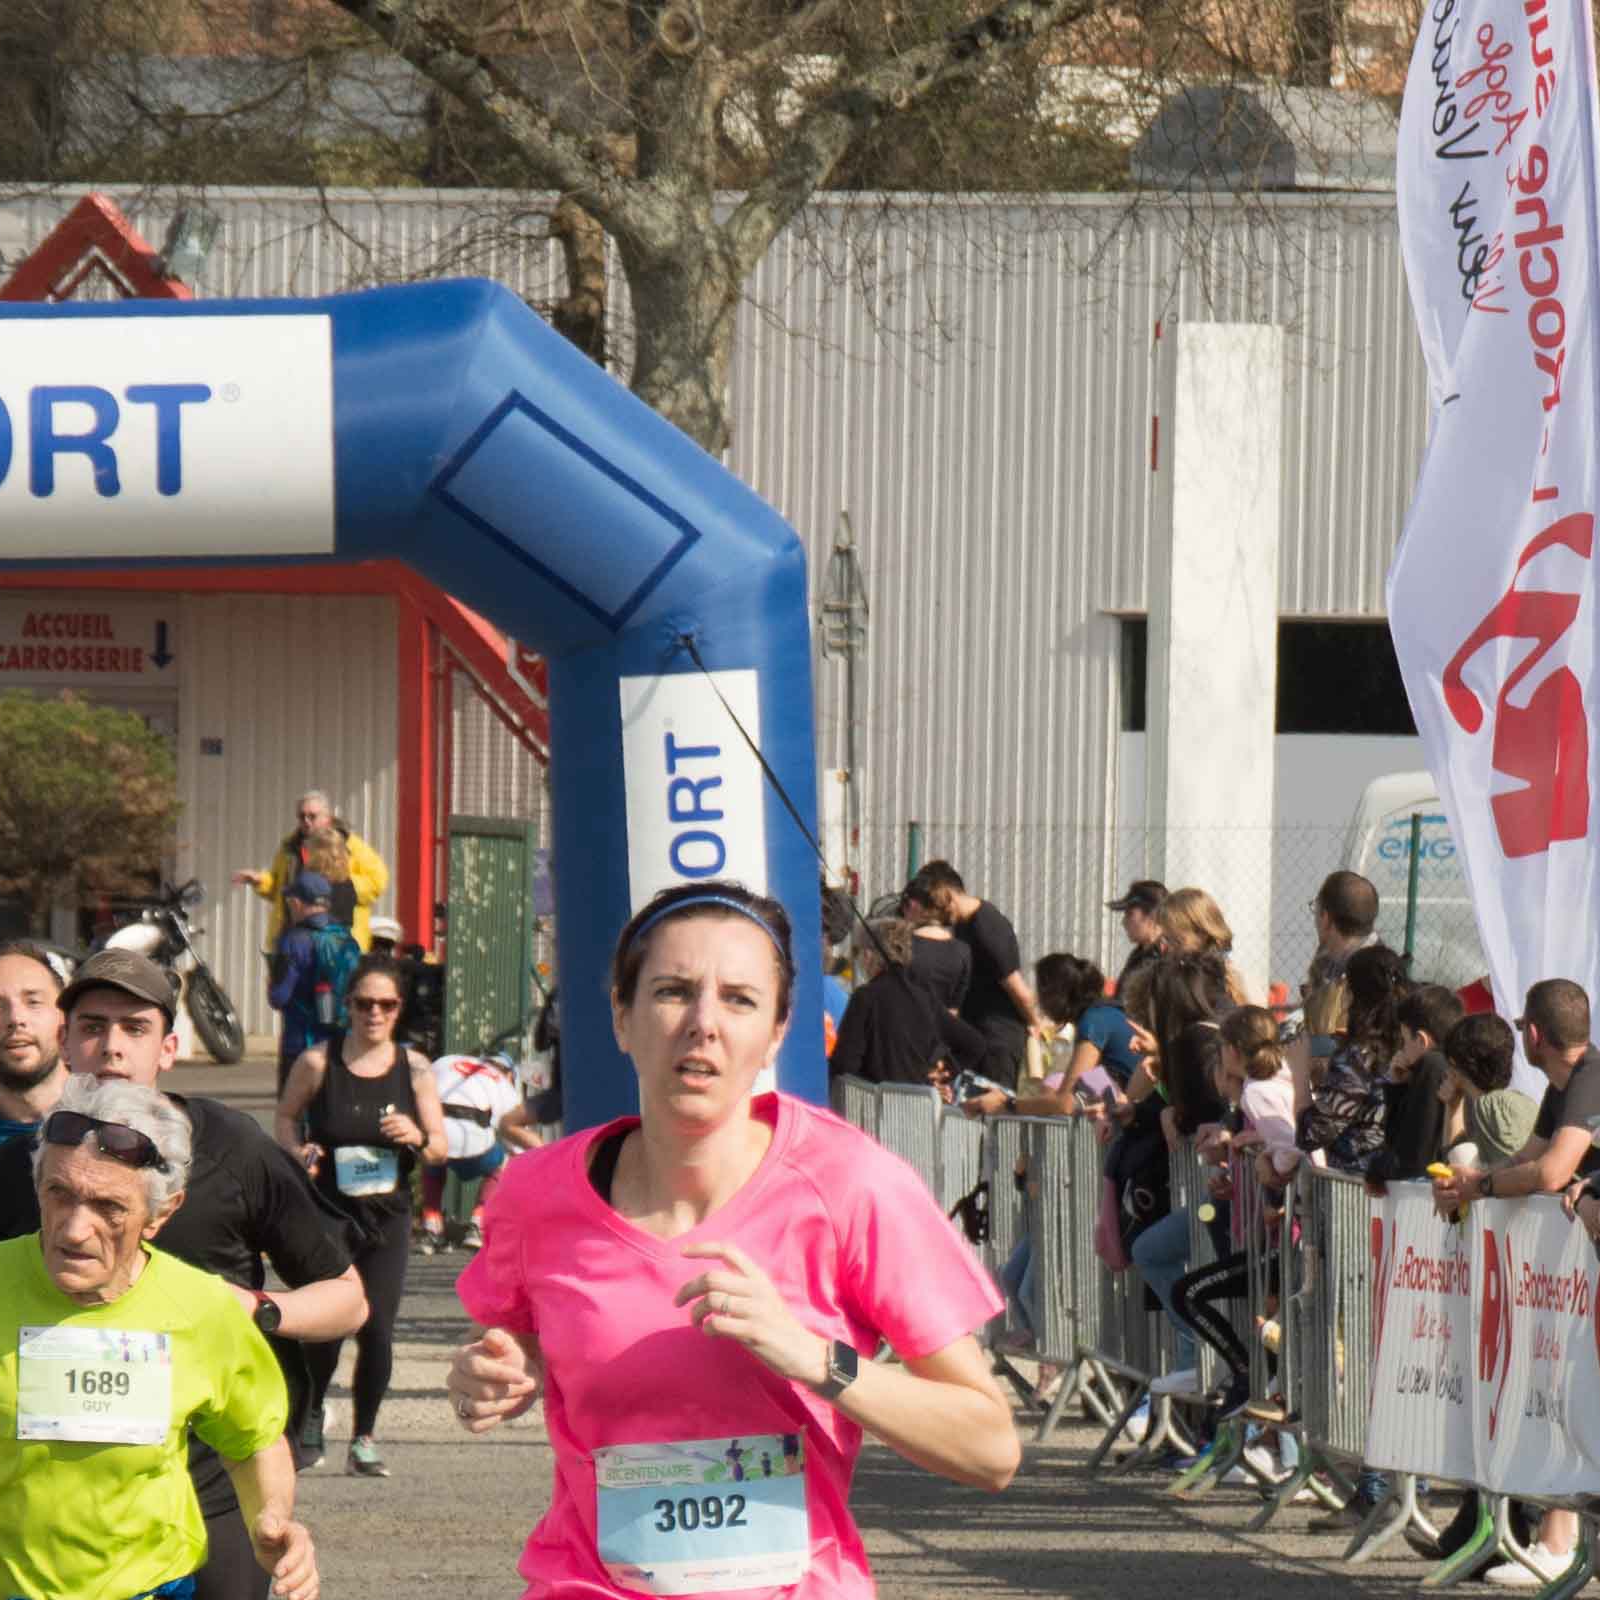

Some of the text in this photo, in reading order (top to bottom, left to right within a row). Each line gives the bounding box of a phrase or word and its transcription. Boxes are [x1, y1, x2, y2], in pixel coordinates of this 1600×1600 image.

[22, 611, 114, 641] ACCUEIL
[64, 1369, 130, 1396] 1689
[82, 1400, 112, 1413] GUY
[653, 1494, 747, 1533] 3092
